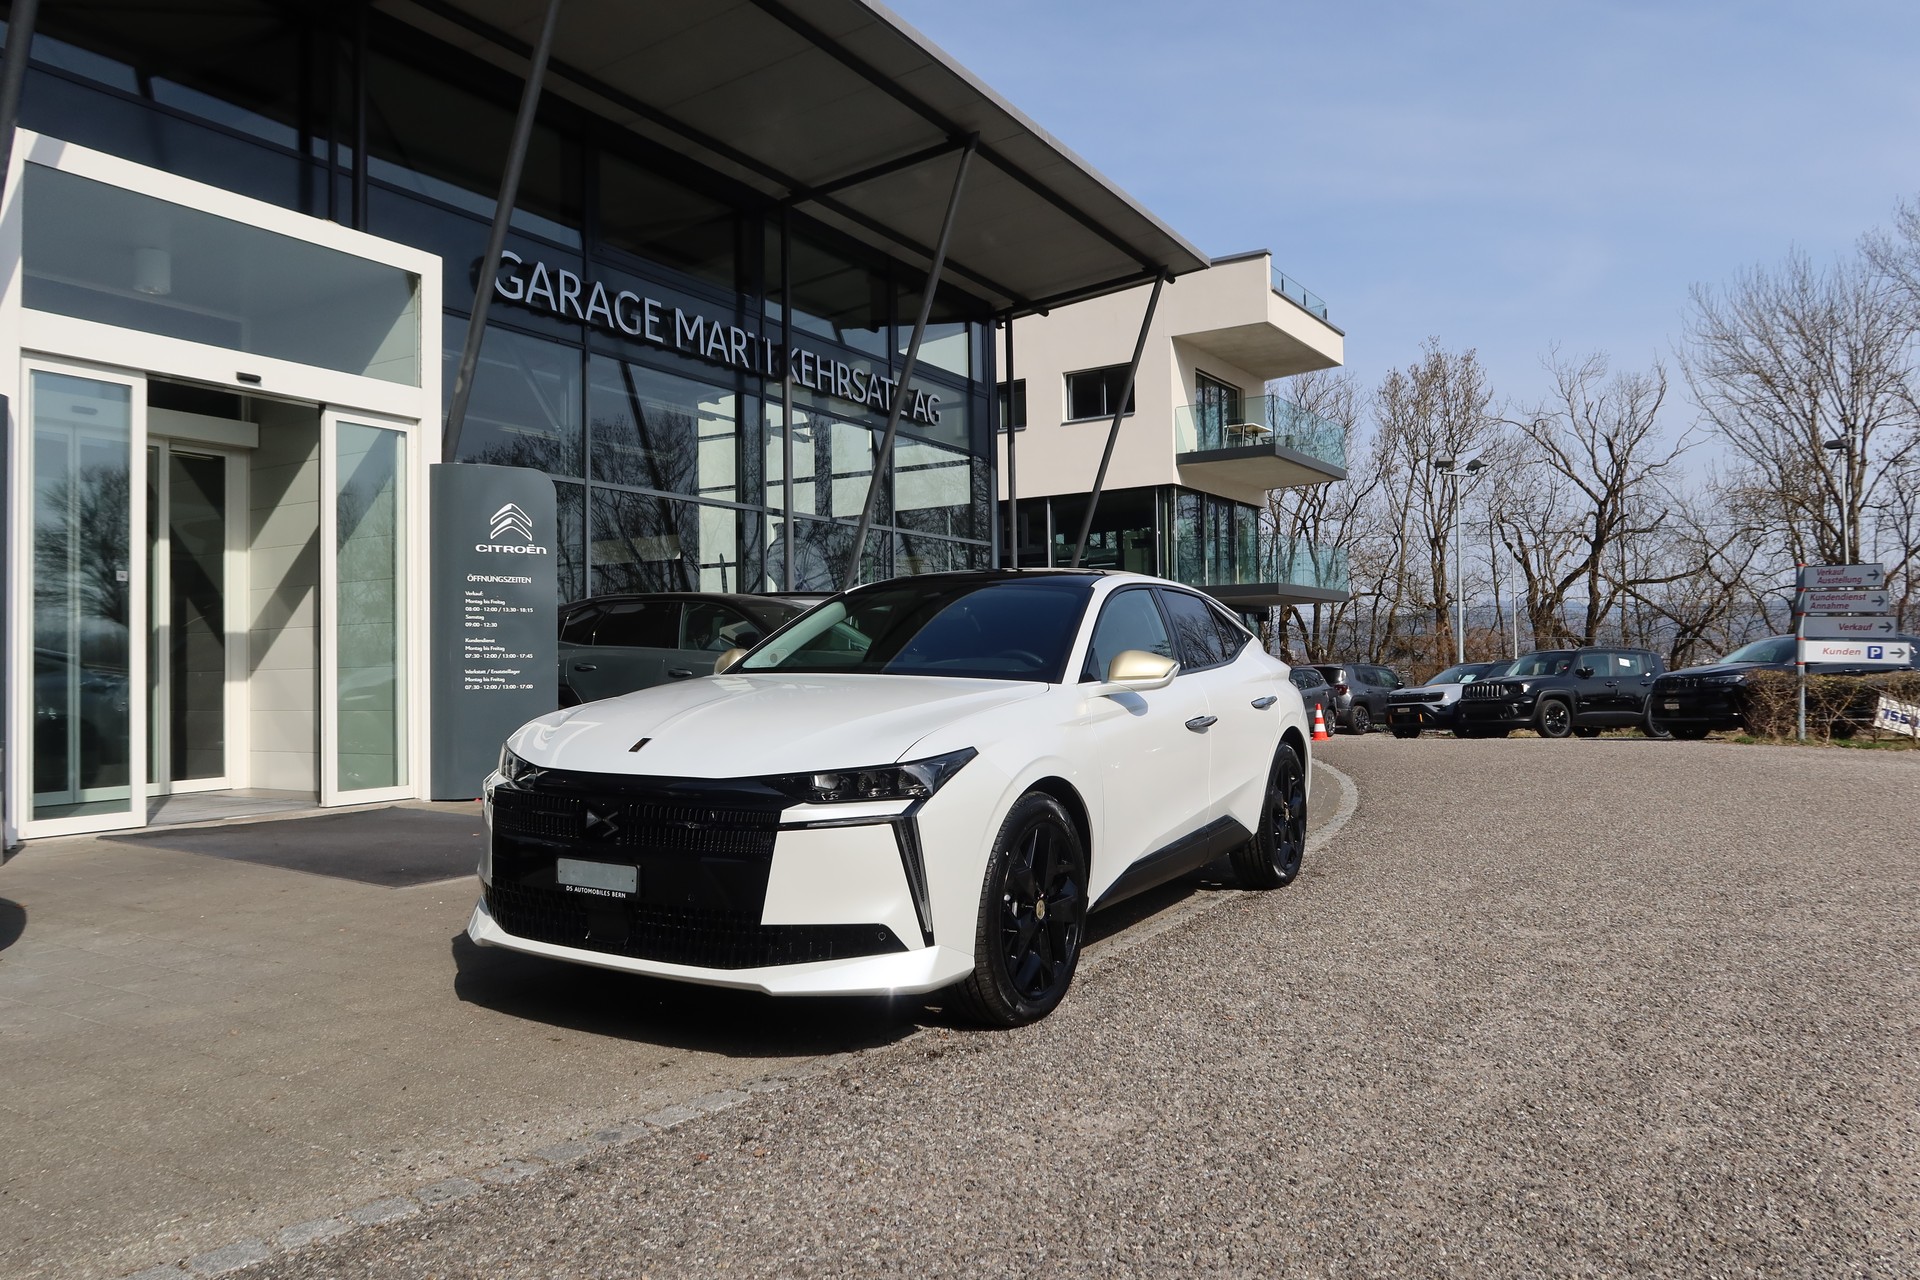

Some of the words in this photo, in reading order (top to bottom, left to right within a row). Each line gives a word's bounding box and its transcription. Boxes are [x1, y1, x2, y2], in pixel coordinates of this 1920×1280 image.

[495, 250, 662, 343] GARAGE
[675, 308, 772, 375] MARTI
[913, 389, 941, 426] AG
[1816, 568, 1846, 576] Verkauf
[467, 574, 532, 584] ÖFFNUNGSZEITEN
[1817, 576, 1862, 584] Ausstellung
[1810, 593, 1866, 601] Kundendienst
[1822, 648, 1861, 656] Kunden
[574, 886, 610, 897] AUTOMOBILES
